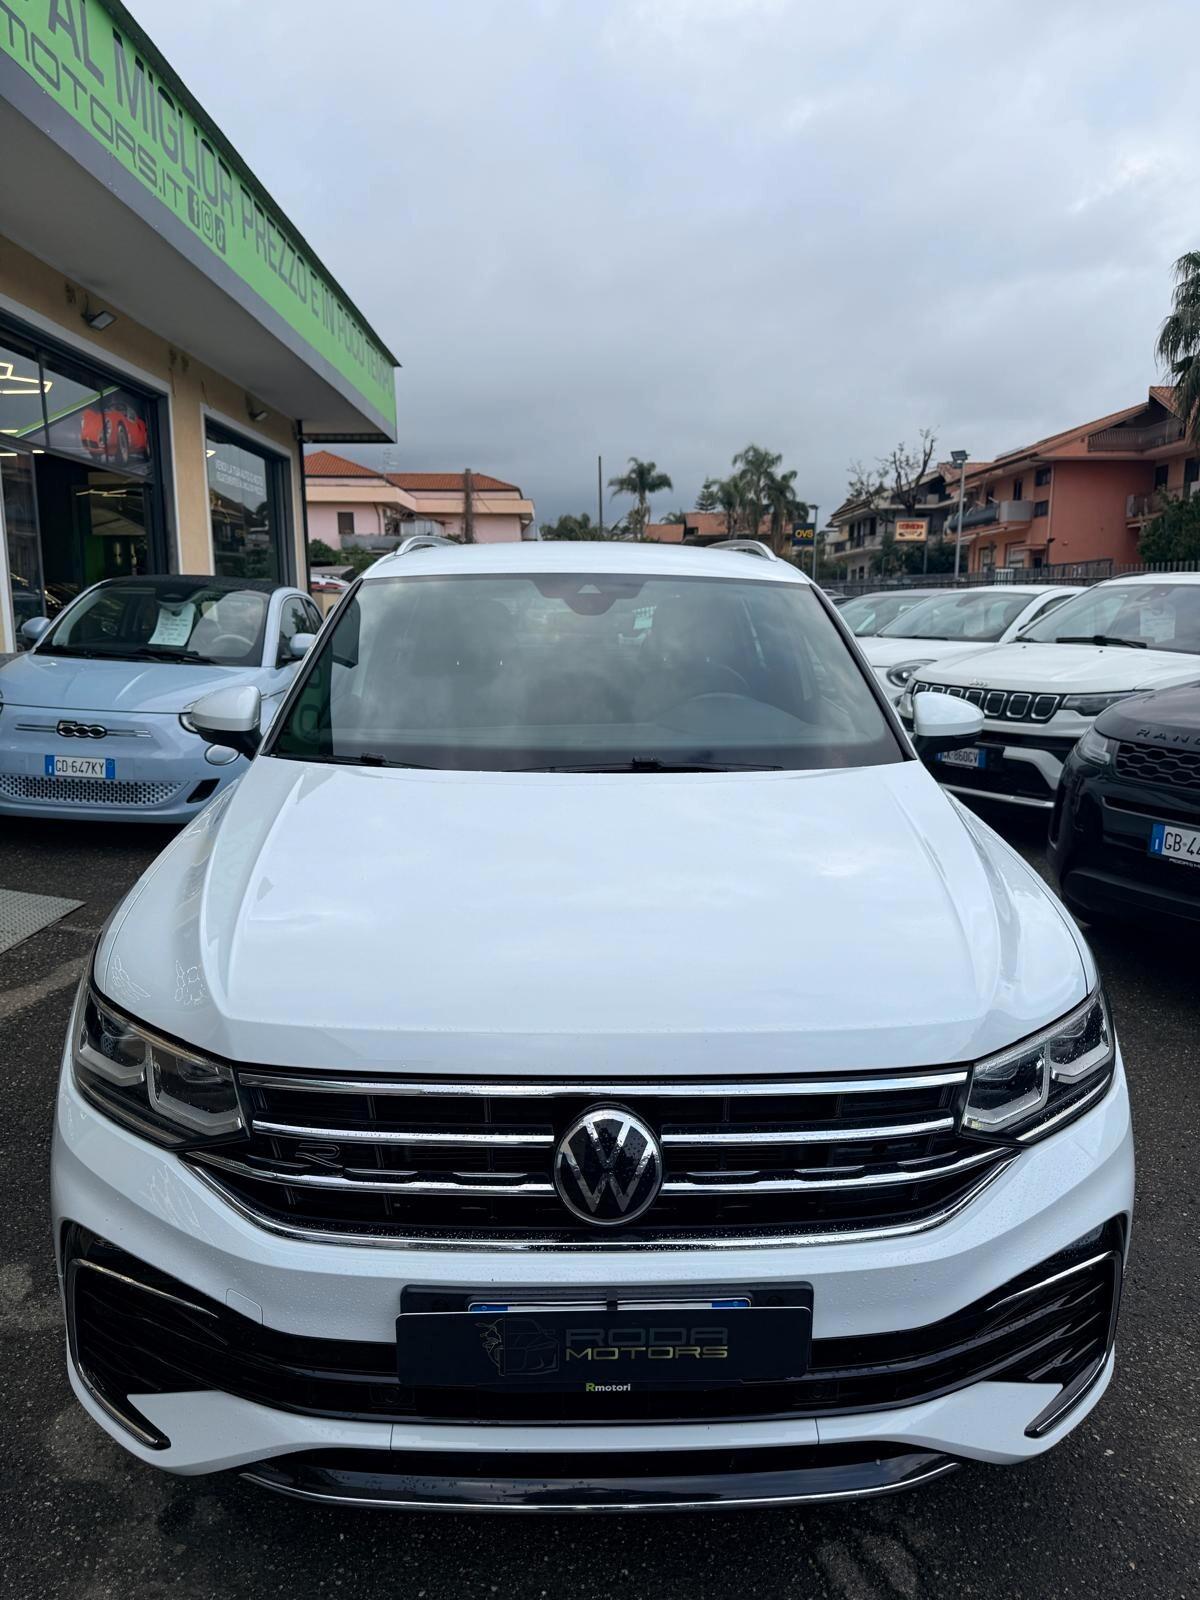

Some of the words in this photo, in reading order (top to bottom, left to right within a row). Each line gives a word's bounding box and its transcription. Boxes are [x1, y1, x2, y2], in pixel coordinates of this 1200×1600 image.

[48, 0, 104, 87] AL
[112, 27, 235, 227] MIGLIOR
[240, 184, 307, 304] PREZZO
[310, 270, 320, 319] E
[321, 283, 336, 336] IN
[795, 529, 814, 538] OVS
[57, 720, 107, 739] 500
[565, 1327, 728, 1346] RODA
[565, 1346, 728, 1361] MOTORS
[585, 1382, 631, 1392] Rmotori
